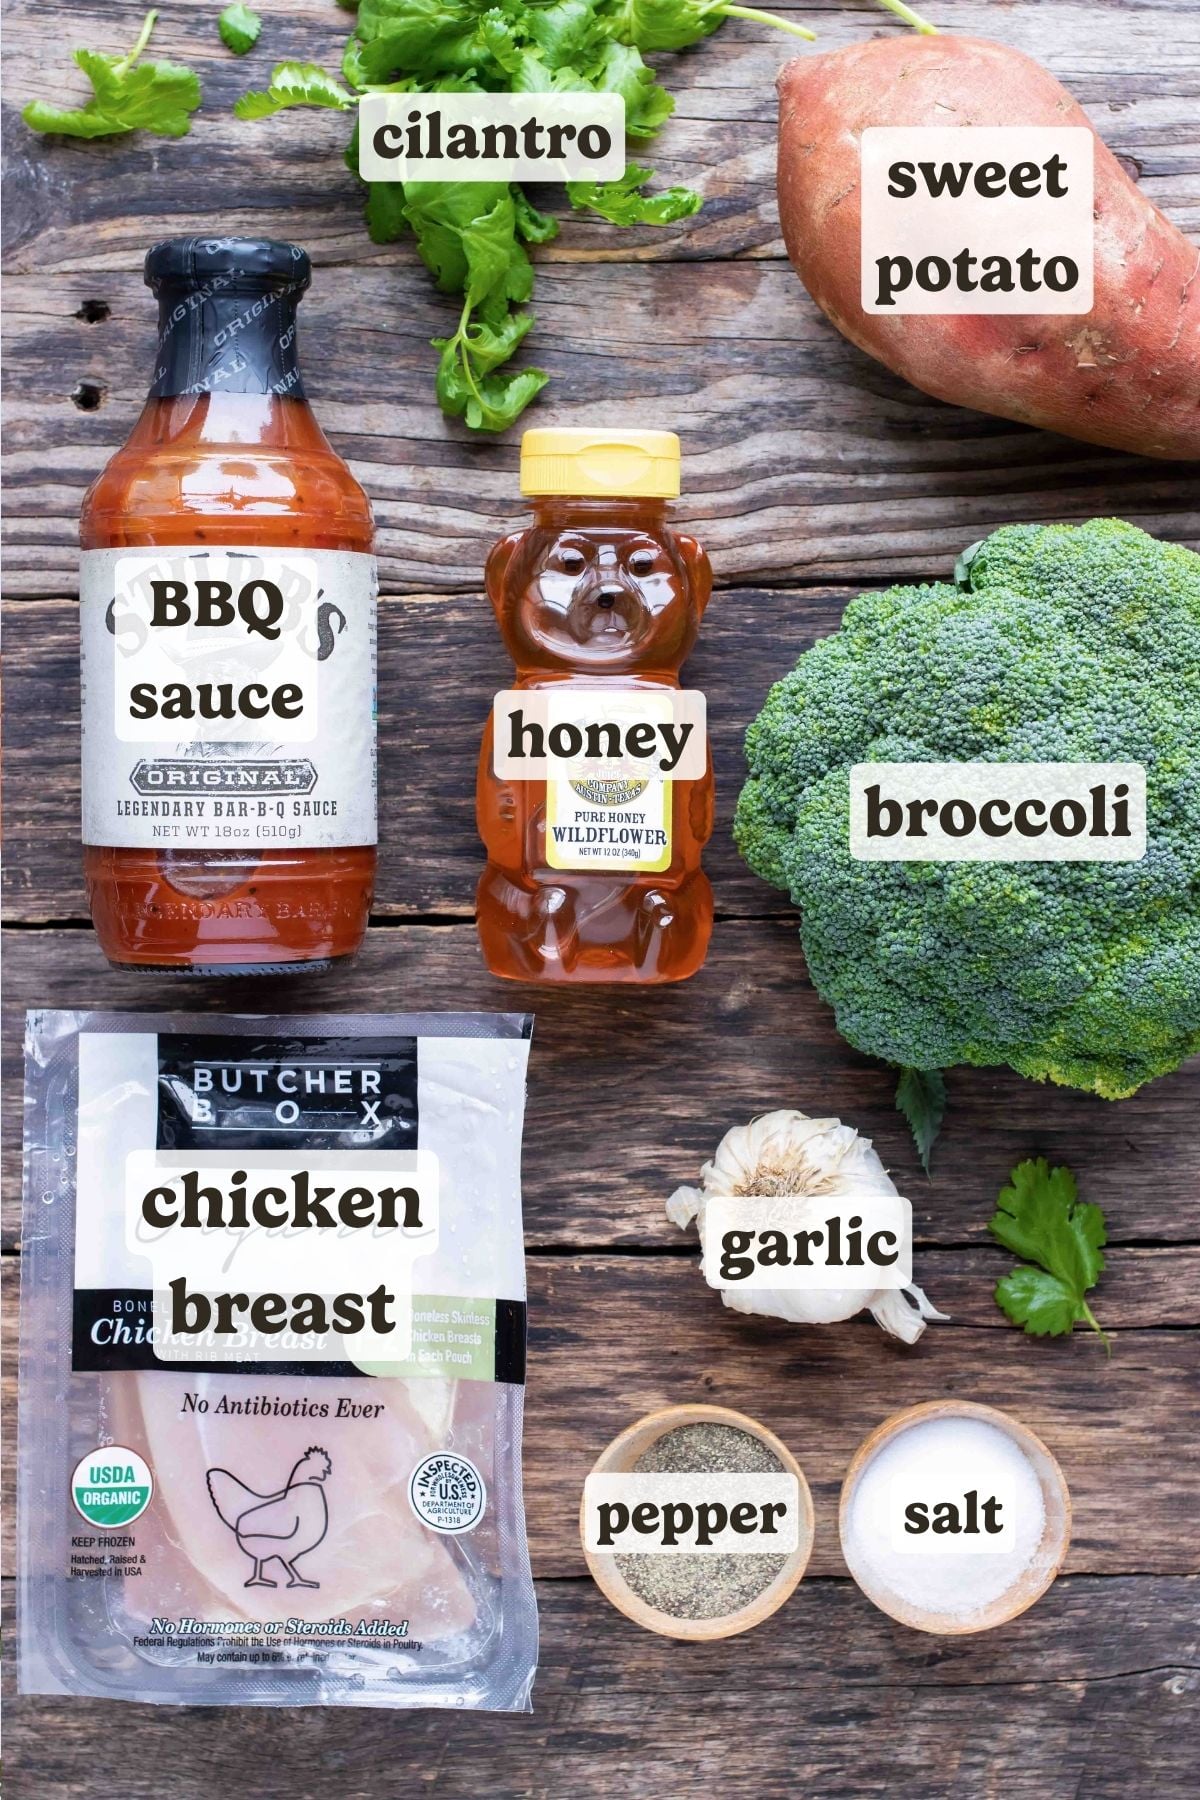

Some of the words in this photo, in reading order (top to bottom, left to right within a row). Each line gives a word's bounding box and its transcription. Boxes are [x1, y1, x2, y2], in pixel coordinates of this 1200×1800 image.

[160, 268, 246, 345] RIGINAL
[147, 770, 300, 785] ORIGINAL
[586, 778, 629, 793] COMPANY
[117, 800, 205, 817] LEGENDARY
[213, 800, 285, 818] BAR-B-Q
[293, 800, 337, 816] SAUCE
[574, 811, 606, 823] PURE
[608, 812, 646, 824] HONEY
[153, 825, 180, 837] NET
[186, 826, 210, 837] WT
[215, 826, 250, 837] 18oz
[552, 826, 667, 845] WILDFLOWER
[579, 848, 591, 856] NET
[592, 848, 602, 856] WT
[604, 848, 610, 856] 12
[612, 848, 621, 857] OZ
[194, 1068, 381, 1094] BUTCHER
[450, 1310, 490, 1325] Skinless
[410, 1328, 445, 1343] hicken
[447, 1330, 482, 1345] Breasts
[418, 1350, 443, 1363] Each
[447, 1351, 473, 1365] Pouch
[181, 1393, 209, 1413] No
[214, 1394, 329, 1417] Antibiotics
[334, 1397, 385, 1418] Ever
[90, 1466, 135, 1483] USDA
[418, 1460, 476, 1492] INSPECTED
[83, 1491, 141, 1505] ORGANIC
[439, 1484, 462, 1500] U.S.
[427, 1507, 471, 1515] AGRICULTURE
[71, 1537, 95, 1547] KEEP
[98, 1537, 135, 1547] FROZEN
[110, 1555, 137, 1564] Raised
[140, 1555, 146, 1563] &
[70, 1567, 112, 1576] Harvested
[115, 1567, 122, 1576] in
[124, 1567, 142, 1576] USA
[150, 1618, 176, 1634] No
[177, 1618, 261, 1634] Hormones
[264, 1621, 283, 1634] or
[285, 1618, 352, 1635] Steroids
[354, 1620, 409, 1636] Added
[134, 1637, 164, 1647] Federal
[167, 1637, 215, 1648] Regulations
[217, 1637, 249, 1647] Prohibit
[251, 1637, 263, 1647] the
[266, 1637, 281, 1647] Use
[294, 1637, 335, 1647] Hormones
[337, 1639, 346, 1647] or
[348, 1638, 380, 1648] Steroids
[383, 1638, 390, 1649] in
[197, 1652, 214, 1664] May
[216, 1652, 247, 1662] contain
[249, 1653, 260, 1664] up
[262, 1652, 270, 1662] to
